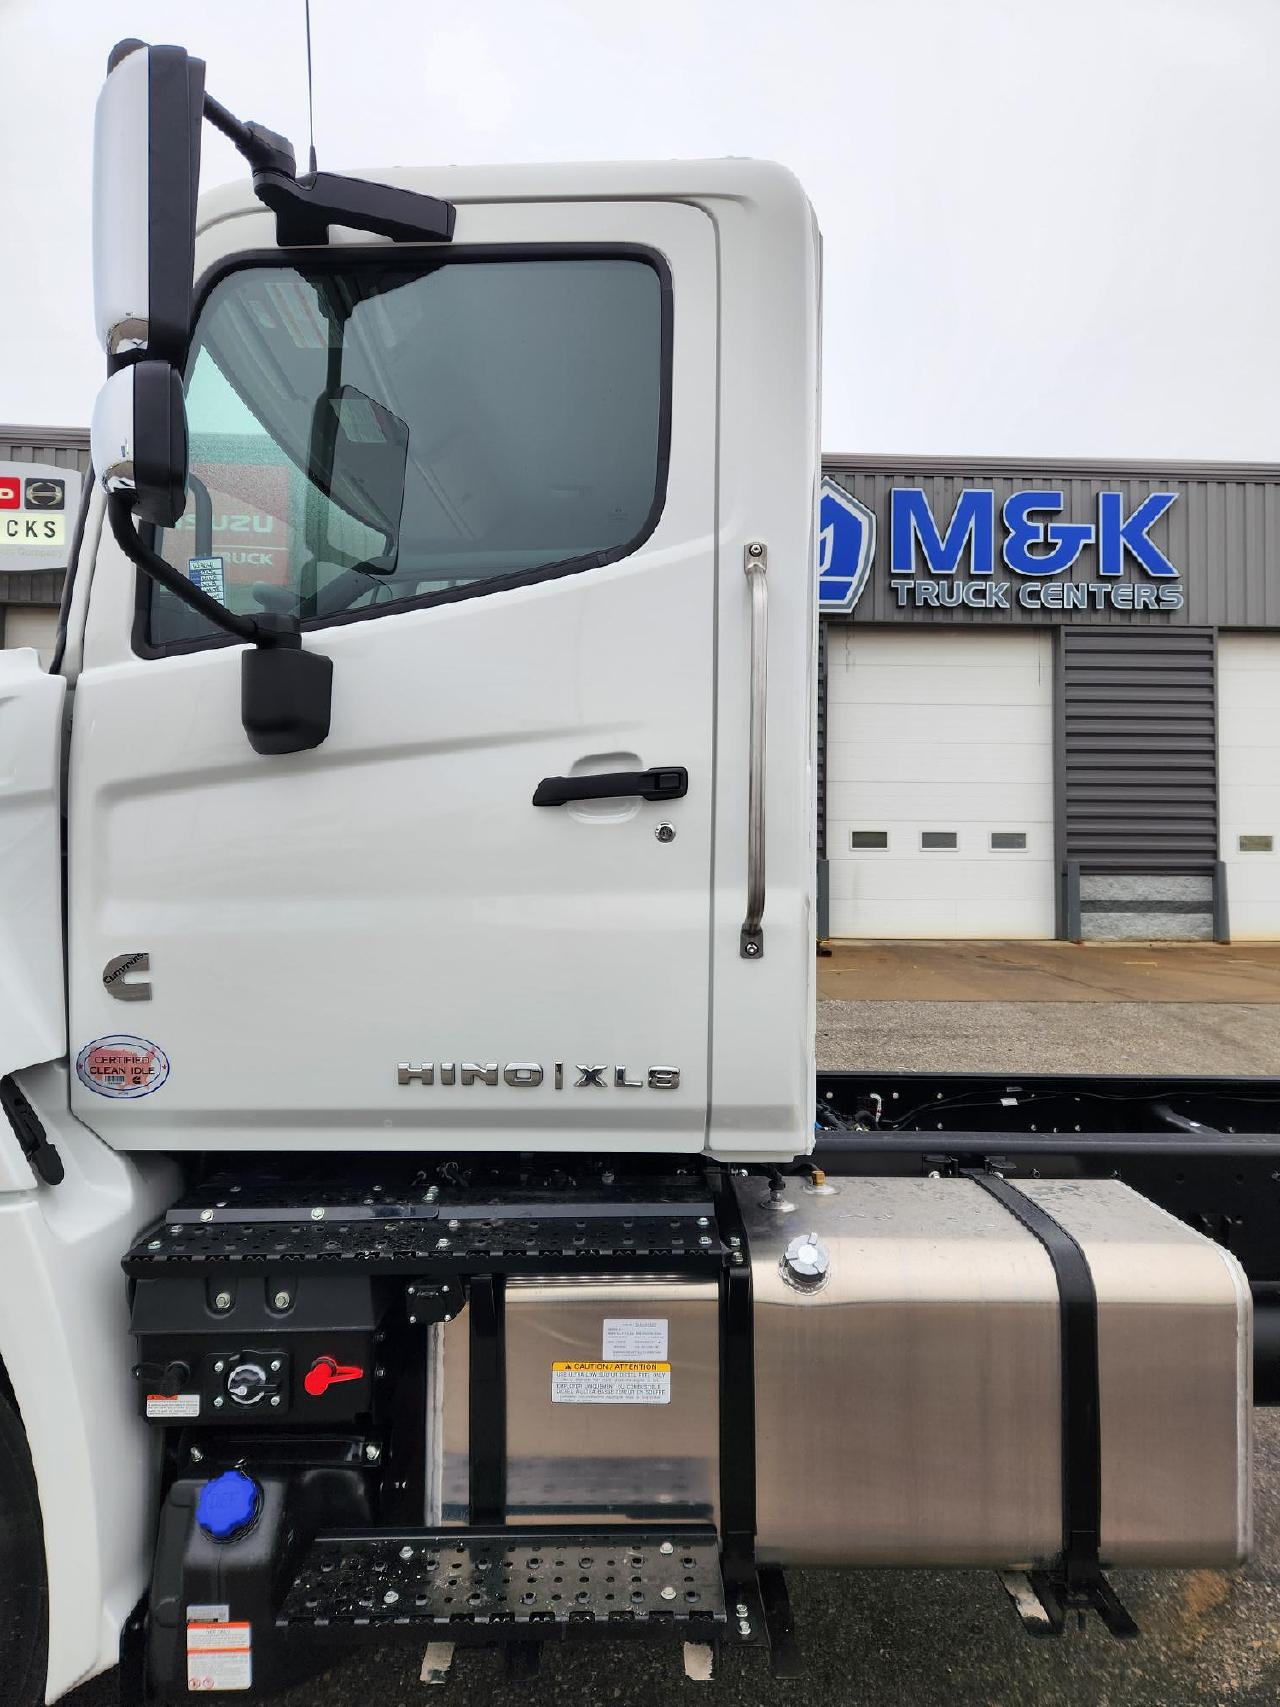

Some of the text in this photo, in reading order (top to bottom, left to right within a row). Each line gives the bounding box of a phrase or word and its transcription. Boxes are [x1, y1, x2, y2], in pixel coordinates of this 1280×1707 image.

[889, 486, 1182, 577] M&K
[891, 580, 1184, 611] TRUCK CENTERS
[89, 1066, 155, 1075] CLEAN IDLE
[95, 1056, 150, 1064] CERTIFIED
[397, 1062, 544, 1088] HINO
